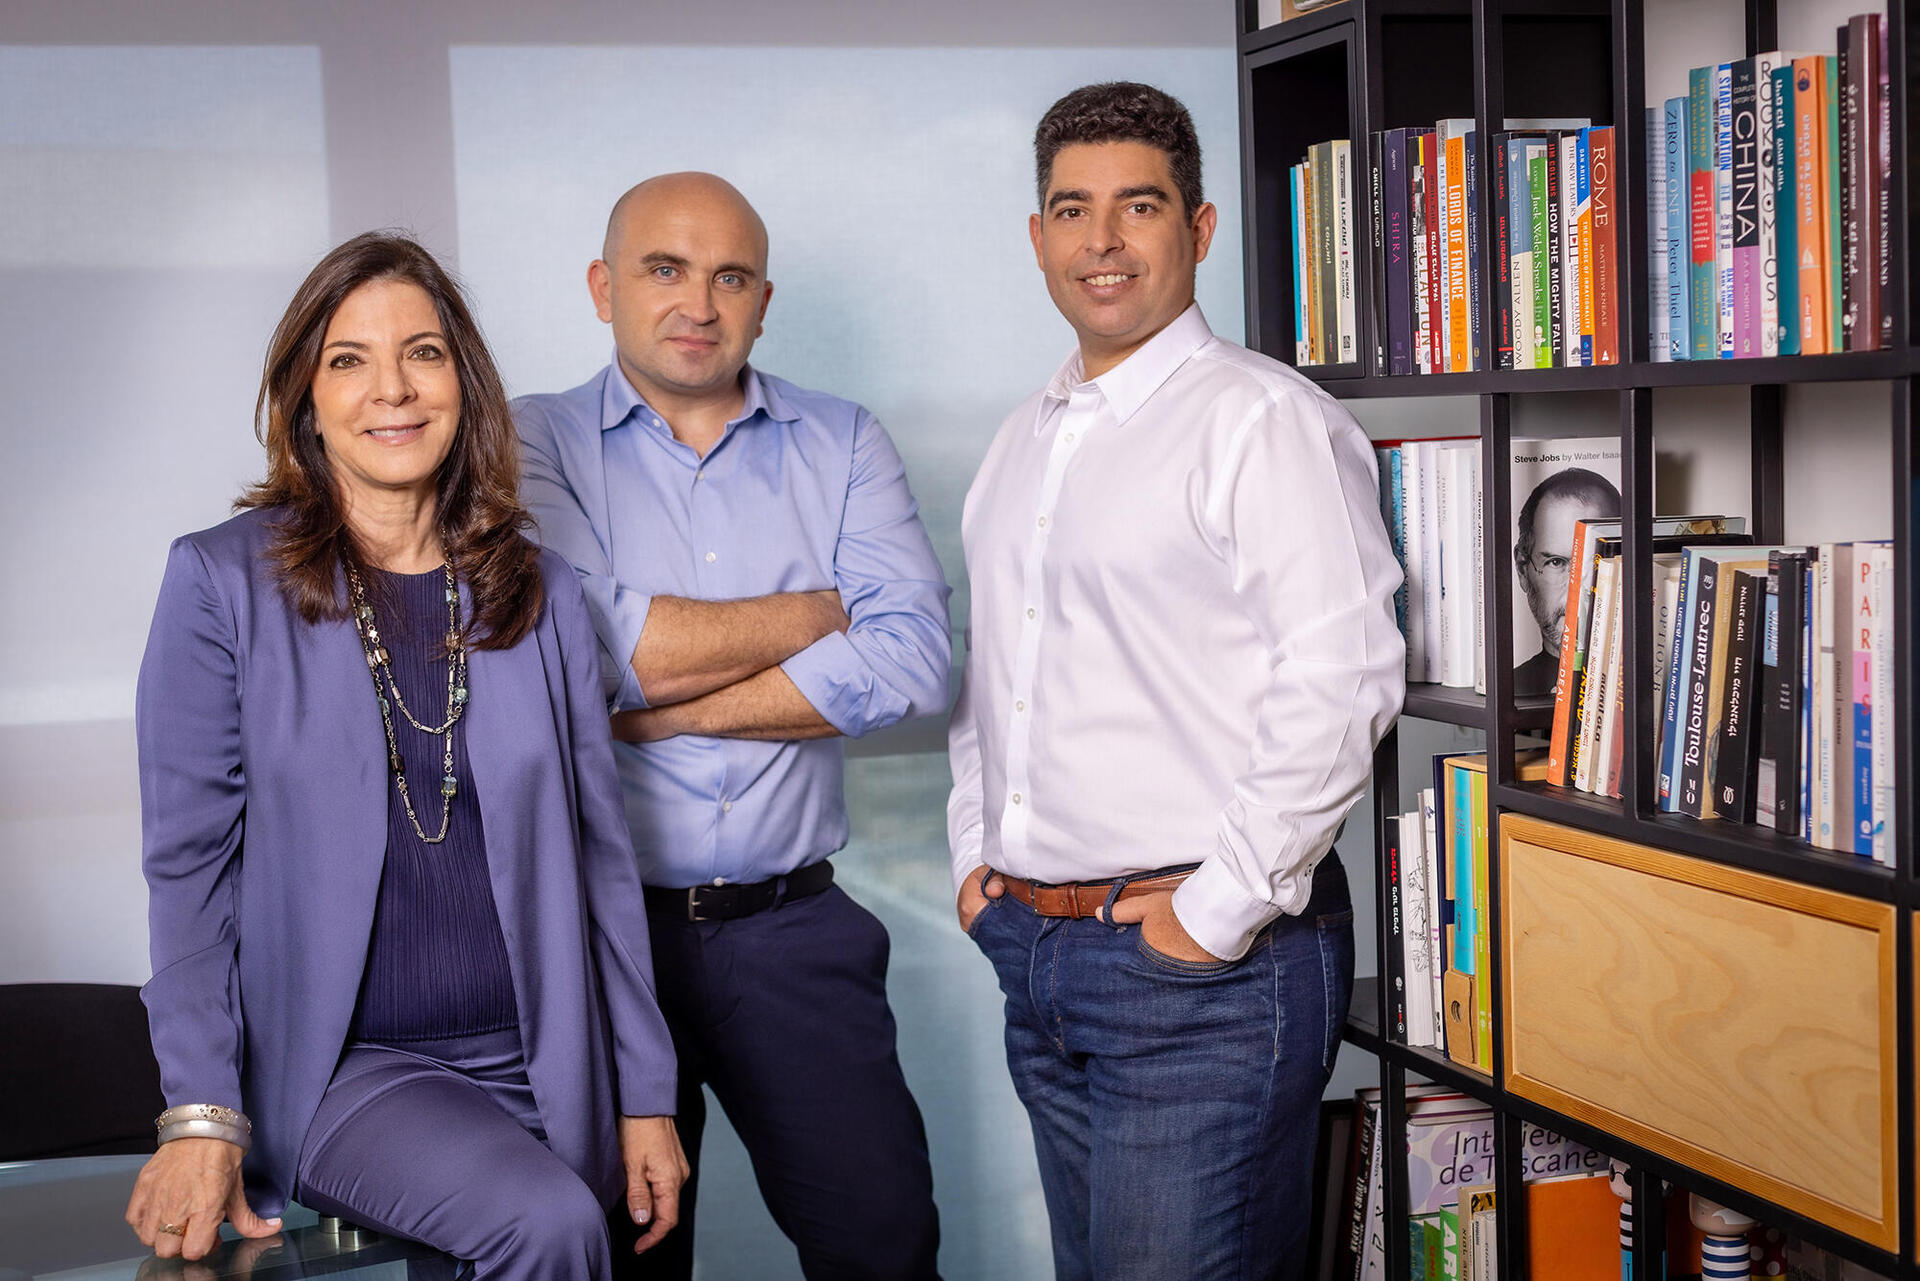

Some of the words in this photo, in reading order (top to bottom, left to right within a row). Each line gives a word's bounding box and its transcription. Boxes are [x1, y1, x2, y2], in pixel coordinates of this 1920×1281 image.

[1719, 76, 1732, 128] START-UP
[1548, 143, 1556, 158] JIM
[1667, 110, 1679, 154] ZERO
[1670, 161, 1676, 172] to
[1719, 132, 1732, 171] NATION
[1549, 160, 1557, 198] COLLINS
[1592, 144, 1608, 228] ROME
[1736, 110, 1756, 242] CHINA
[1448, 184, 1462, 226] LORDS
[1532, 194, 1542, 220] Jack
[1668, 178, 1680, 216] ONE
[1391, 210, 1401, 265] SHIRA
[1450, 230, 1463, 244] OF
[1549, 203, 1558, 234] HOW
[1532, 222, 1542, 258] Welch
[1550, 239, 1559, 264] THE
[1669, 238, 1680, 276] Peter
[1450, 250, 1464, 301] FINANCE
[1513, 262, 1521, 305] ALLEN
[1532, 261, 1543, 302] Speaks
[1583, 266, 1590, 275] OF
[1418, 255, 1430, 346] CLAPTON
[1550, 268, 1560, 319] MIGHTY
[1670, 281, 1681, 319] Thiel
[1514, 310, 1522, 365] WOODY
[1552, 323, 1561, 354] FALL
[1514, 455, 1538, 464] Steve
[1540, 454, 1560, 462] Jobs
[1561, 453, 1573, 462] by
[1573, 452, 1600, 460] Walter
[1602, 451, 1622, 460] Isaa
[1570, 538, 1578, 585] HOROWITZ
[1562, 624, 1570, 651] ART
[1654, 606, 1669, 676] OPTION
[1736, 619, 1745, 642] סטון
[1859, 562, 1873, 716] PARIS
[1684, 600, 1711, 768] Toulouse-Lautrec
[1732, 656, 1743, 674] חיי
[1556, 668, 1566, 703] DEAL
[1652, 680, 1662, 692] B
[1452, 1123, 1570, 1158] Intieu
[1439, 1156, 1474, 1186] de
[1480, 1149, 1599, 1180] Tscane
[1354, 1176, 1365, 1209] LIVING
[1352, 1212, 1362, 1222] IN
[1350, 1222, 1361, 1253] JAPAN
[1442, 1220, 1458, 1281] AR
